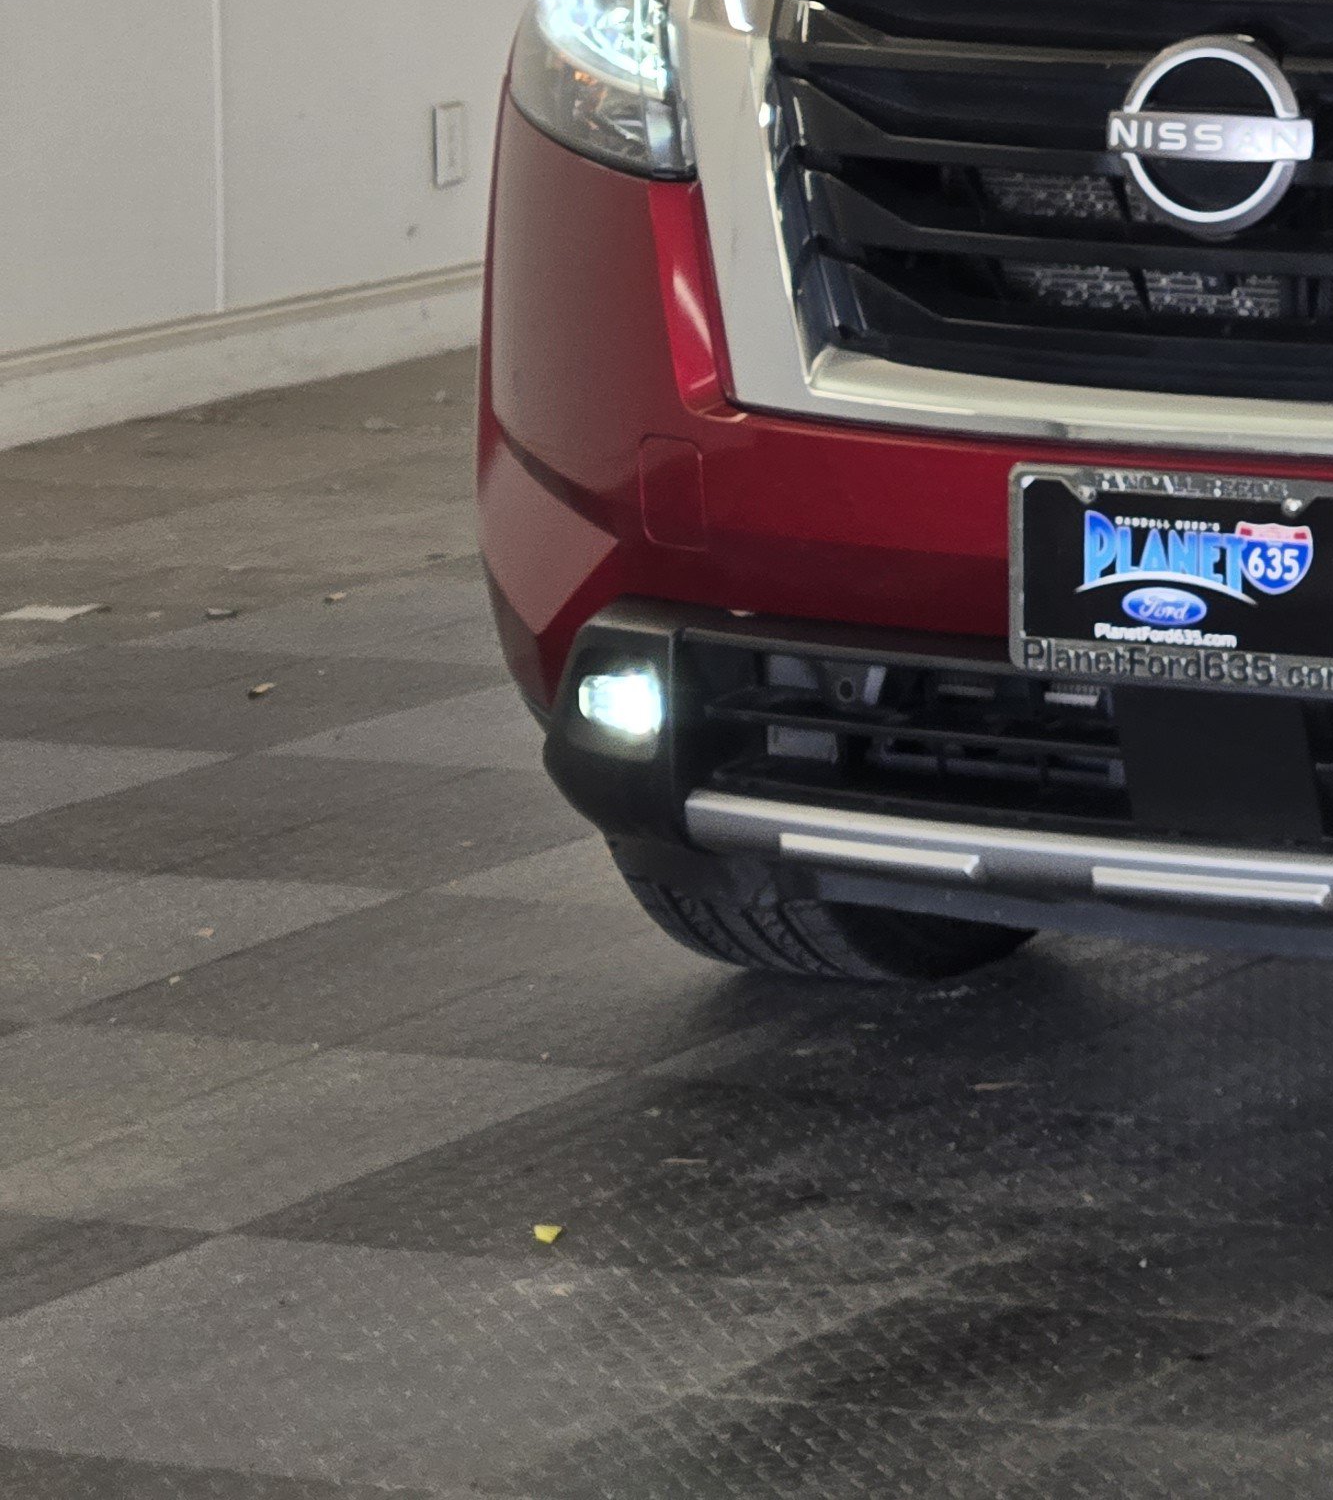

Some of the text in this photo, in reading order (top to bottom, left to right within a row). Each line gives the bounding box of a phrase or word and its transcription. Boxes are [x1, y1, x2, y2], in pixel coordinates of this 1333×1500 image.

[1108, 117, 1302, 155] NISSAN
[1084, 509, 1300, 594] PLANET 635
[1138, 594, 1191, 622] Ford
